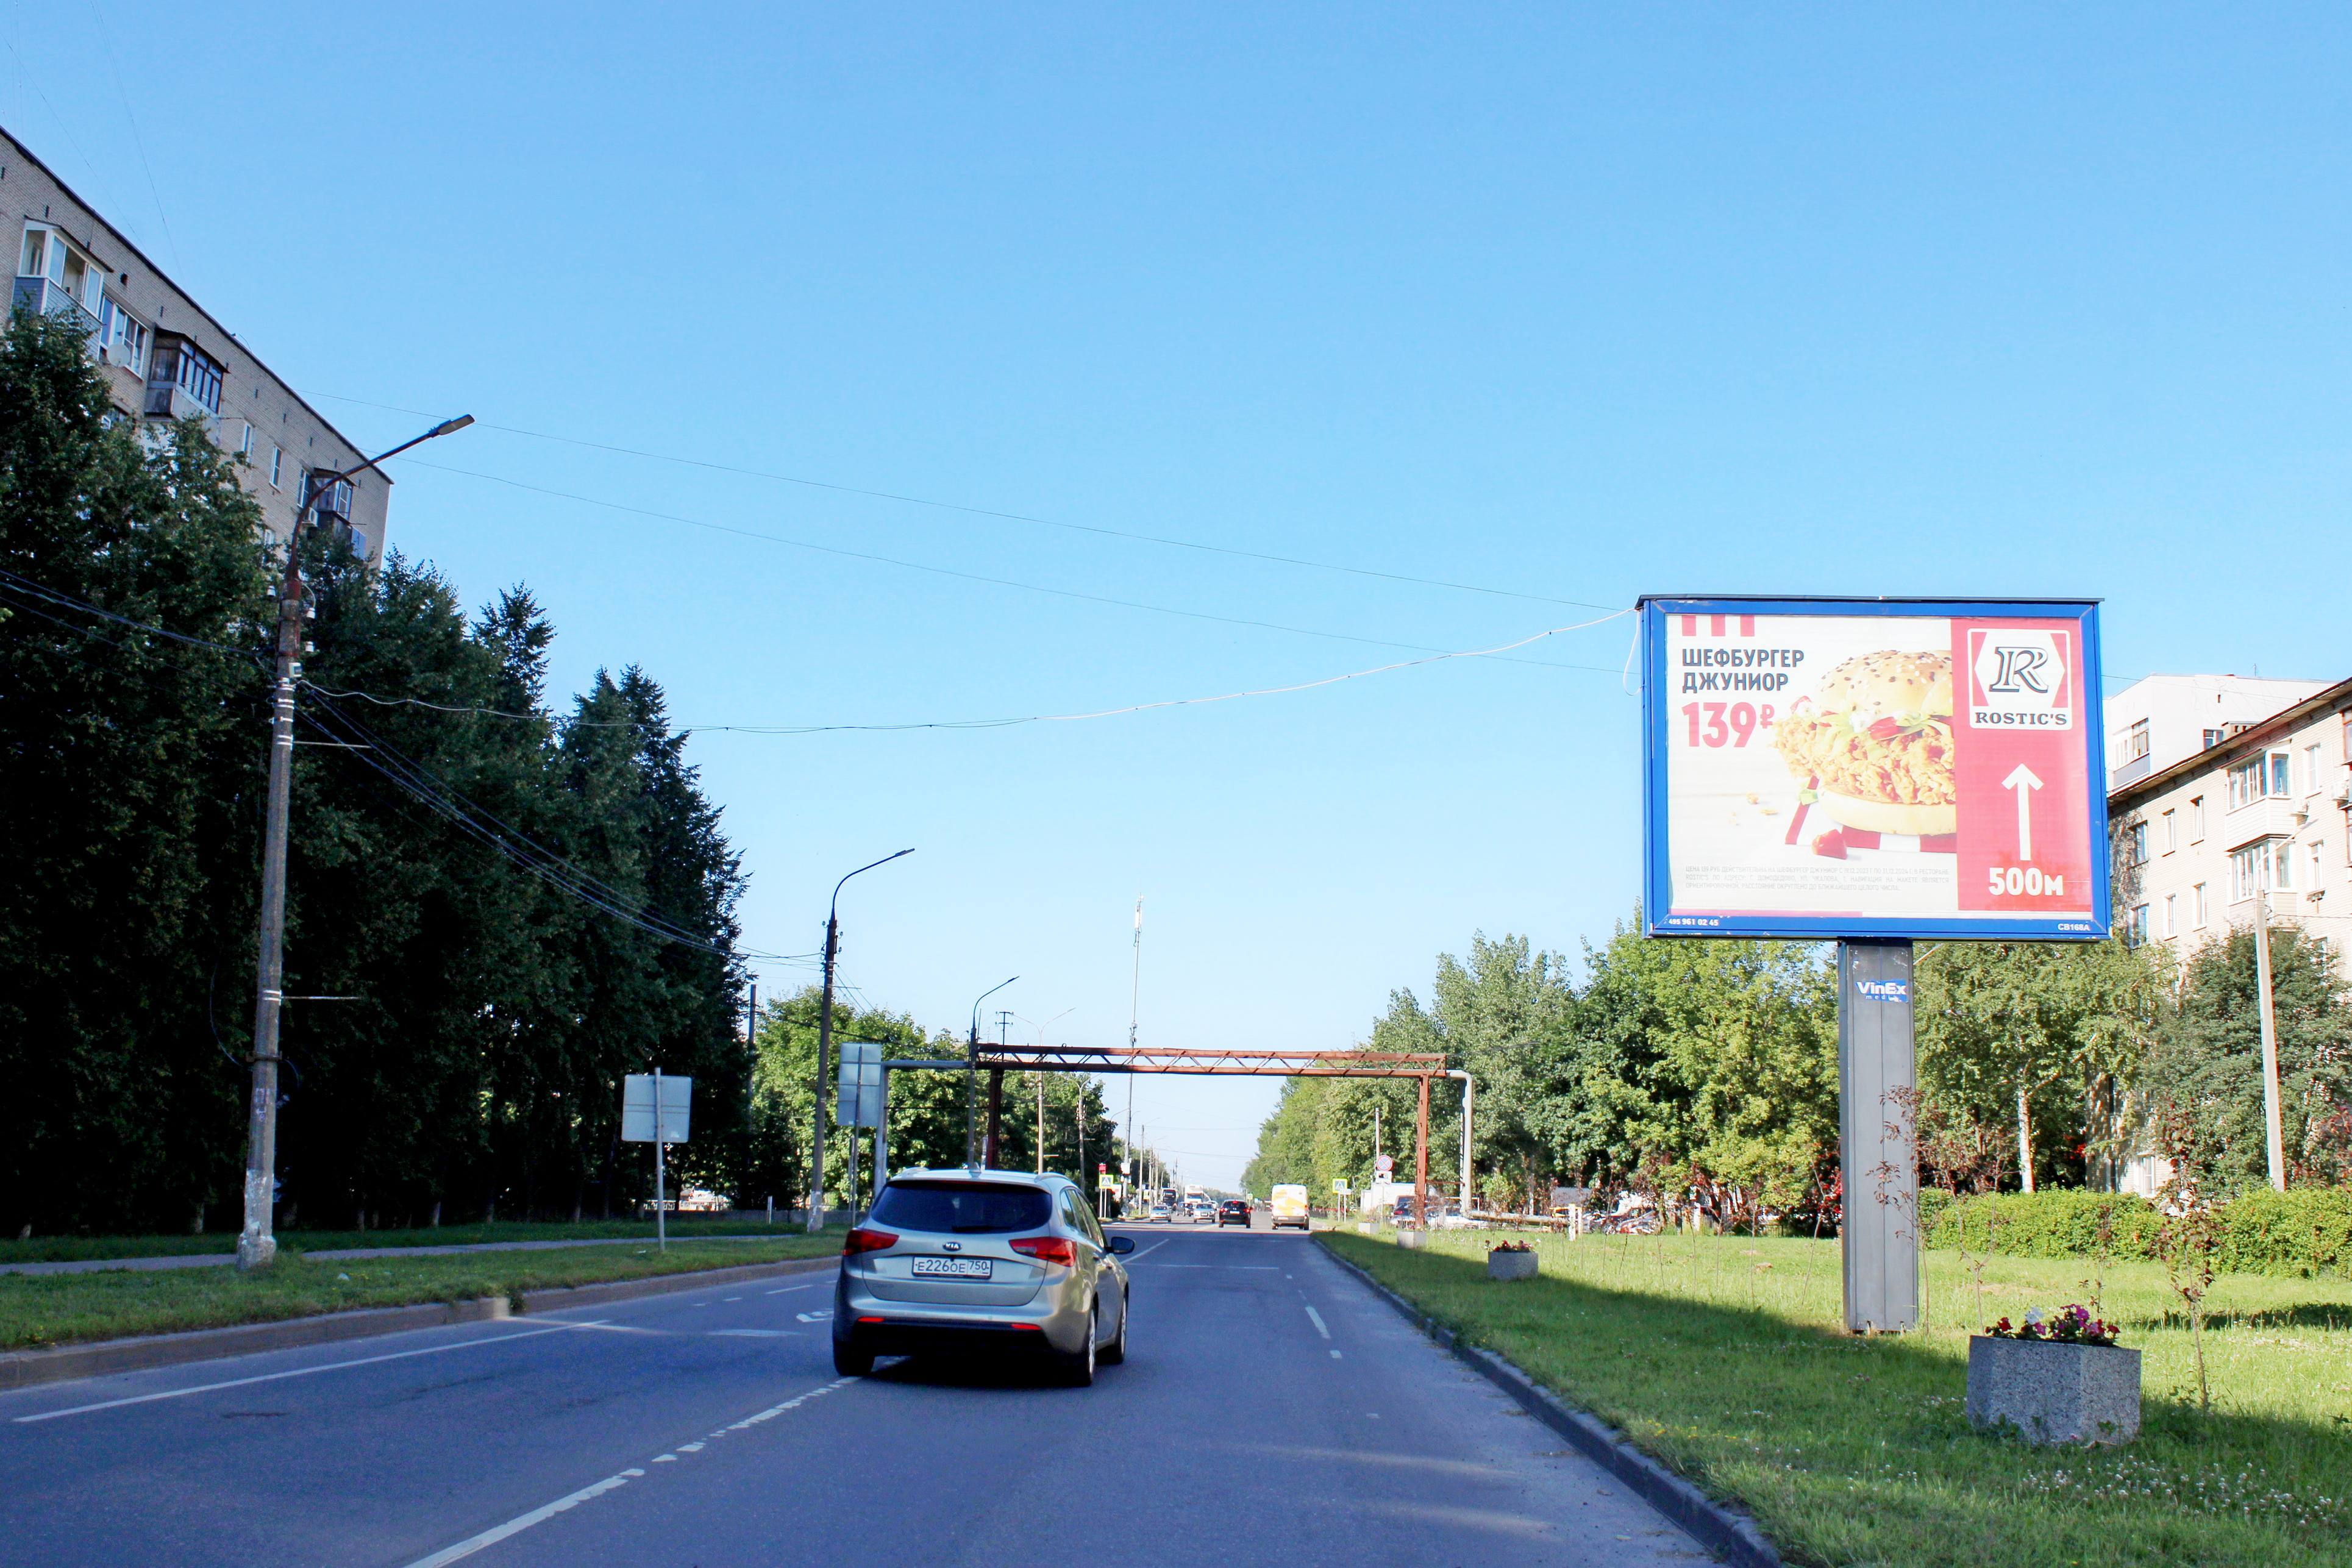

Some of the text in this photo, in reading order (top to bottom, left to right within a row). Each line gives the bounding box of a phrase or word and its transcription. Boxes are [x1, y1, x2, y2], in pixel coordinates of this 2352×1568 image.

[1682, 649, 1805, 667] ШЕФБУРГЕР
[1989, 646, 2048, 694] R
[1682, 672, 1789, 694] ДЖУНИОР
[1975, 712, 2067, 725] ROSTIC'S
[1856, 982, 1907, 995] VinEx
[969, 1260, 988, 1270] 750
